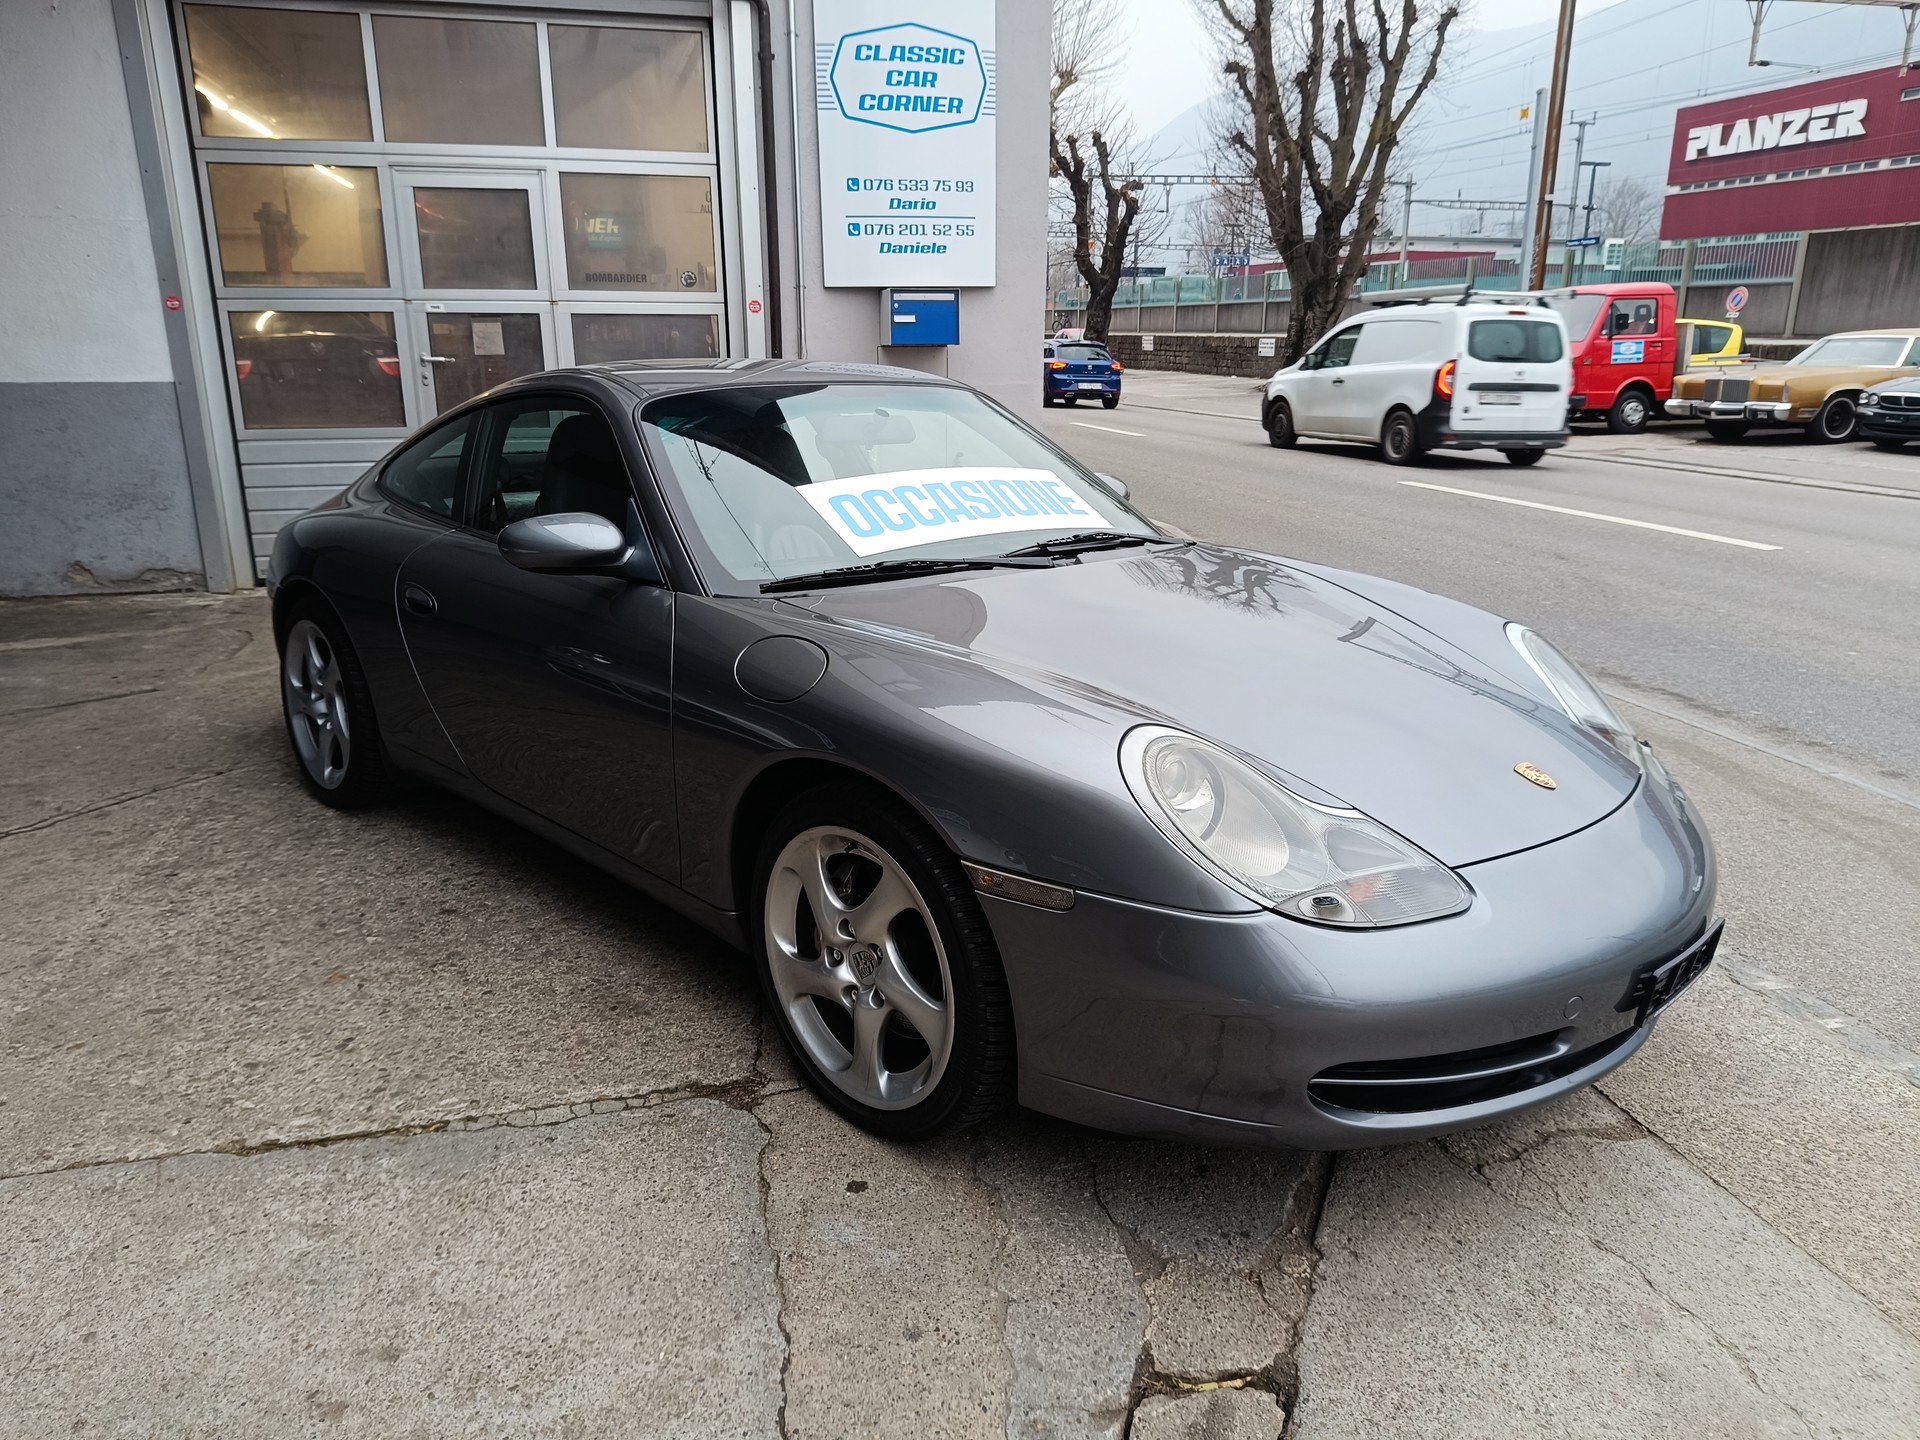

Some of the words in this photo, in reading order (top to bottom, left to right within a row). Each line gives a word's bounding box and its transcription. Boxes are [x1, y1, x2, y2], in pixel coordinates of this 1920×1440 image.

[854, 44, 965, 65] CLASSIC
[886, 70, 938, 89] CAR
[858, 94, 963, 114] CORNER
[1684, 98, 1868, 162] PLANZER
[863, 178, 894, 192] 076
[898, 179, 929, 192] 533
[932, 179, 952, 192] 75
[955, 180, 974, 193] 93
[889, 197, 937, 210] Dario
[864, 223, 895, 236] 076
[898, 223, 928, 236] 201
[932, 223, 953, 236] 52
[955, 224, 975, 237] 55
[879, 242, 948, 254] Daniele
[585, 272, 648, 283] BOMBARDIER
[828, 479, 1089, 538] OCCASIONE
